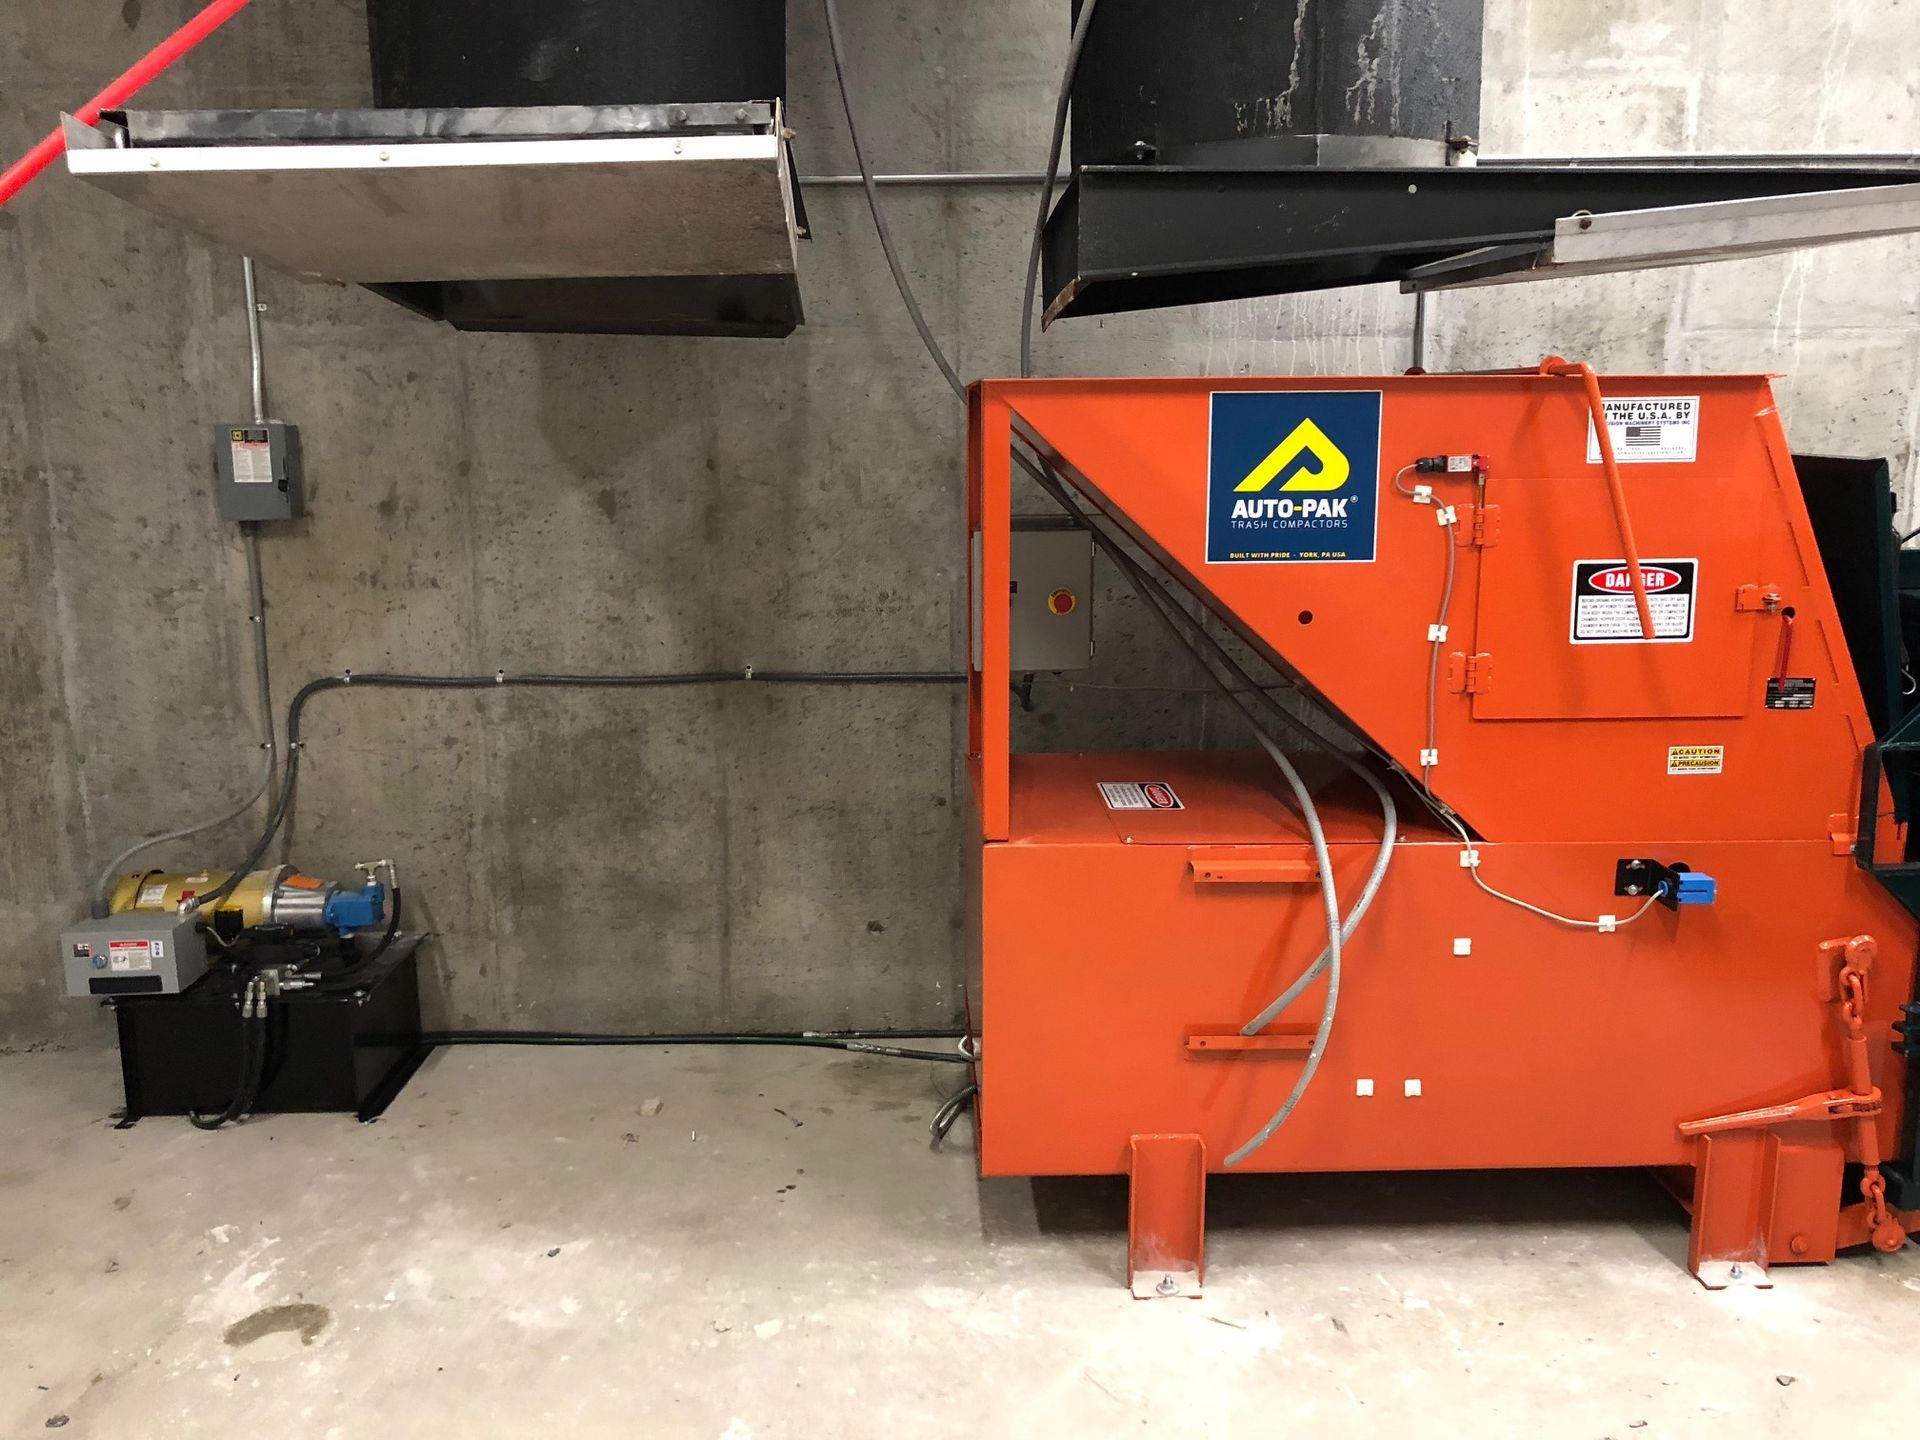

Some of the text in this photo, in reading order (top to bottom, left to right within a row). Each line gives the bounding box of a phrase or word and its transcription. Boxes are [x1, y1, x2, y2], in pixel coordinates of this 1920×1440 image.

[1612, 412, 1634, 420] THE
[1638, 412, 1671, 420] U.S.A.
[1676, 411, 1691, 419] BY
[1231, 499, 1348, 518] AUTO-PAK
[1231, 519, 1348, 529] TRASH COMPACTORS
